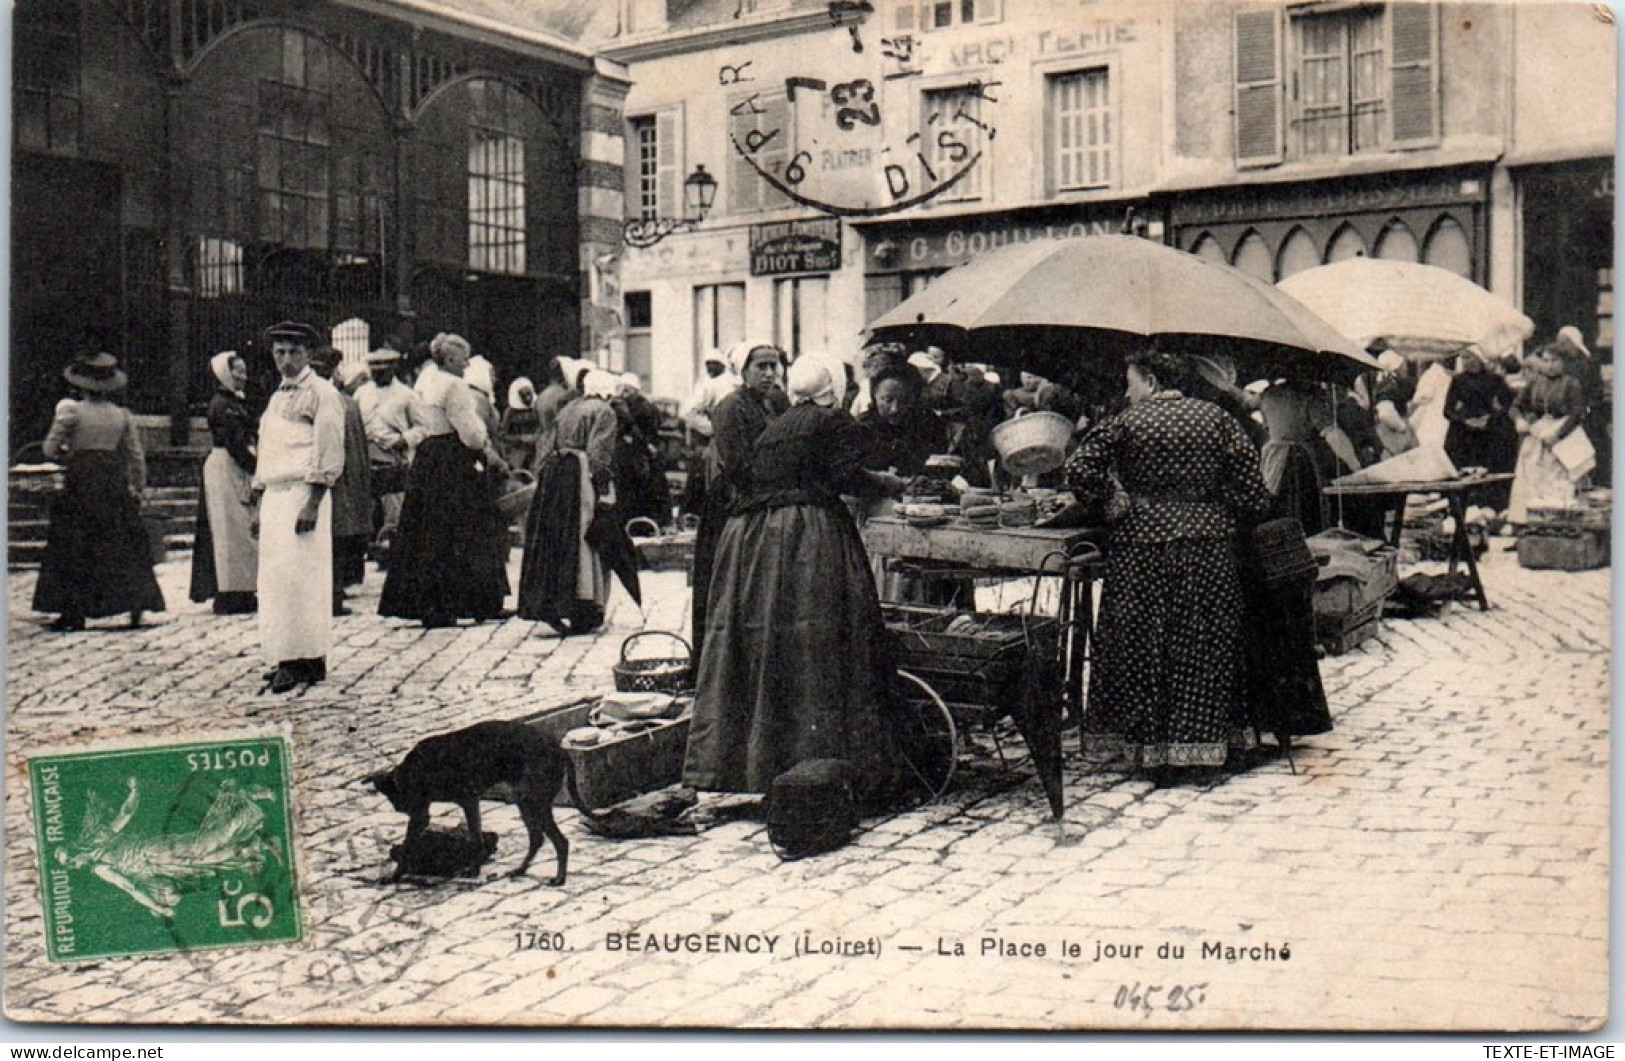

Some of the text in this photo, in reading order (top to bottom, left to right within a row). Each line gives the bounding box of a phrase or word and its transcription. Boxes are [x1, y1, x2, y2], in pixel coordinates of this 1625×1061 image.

[187, 750, 271, 771] POSTES
[606, 932, 781, 954] BEAUGENCY
[794, 930, 883, 958] (Loiret)
[937, 937, 966, 957] La
[979, 937, 1047, 958] Place
[1062, 938, 1082, 959] le
[1093, 939, 1144, 961] jour
[1157, 940, 1185, 960] du
[1201, 940, 1292, 962] Marché
